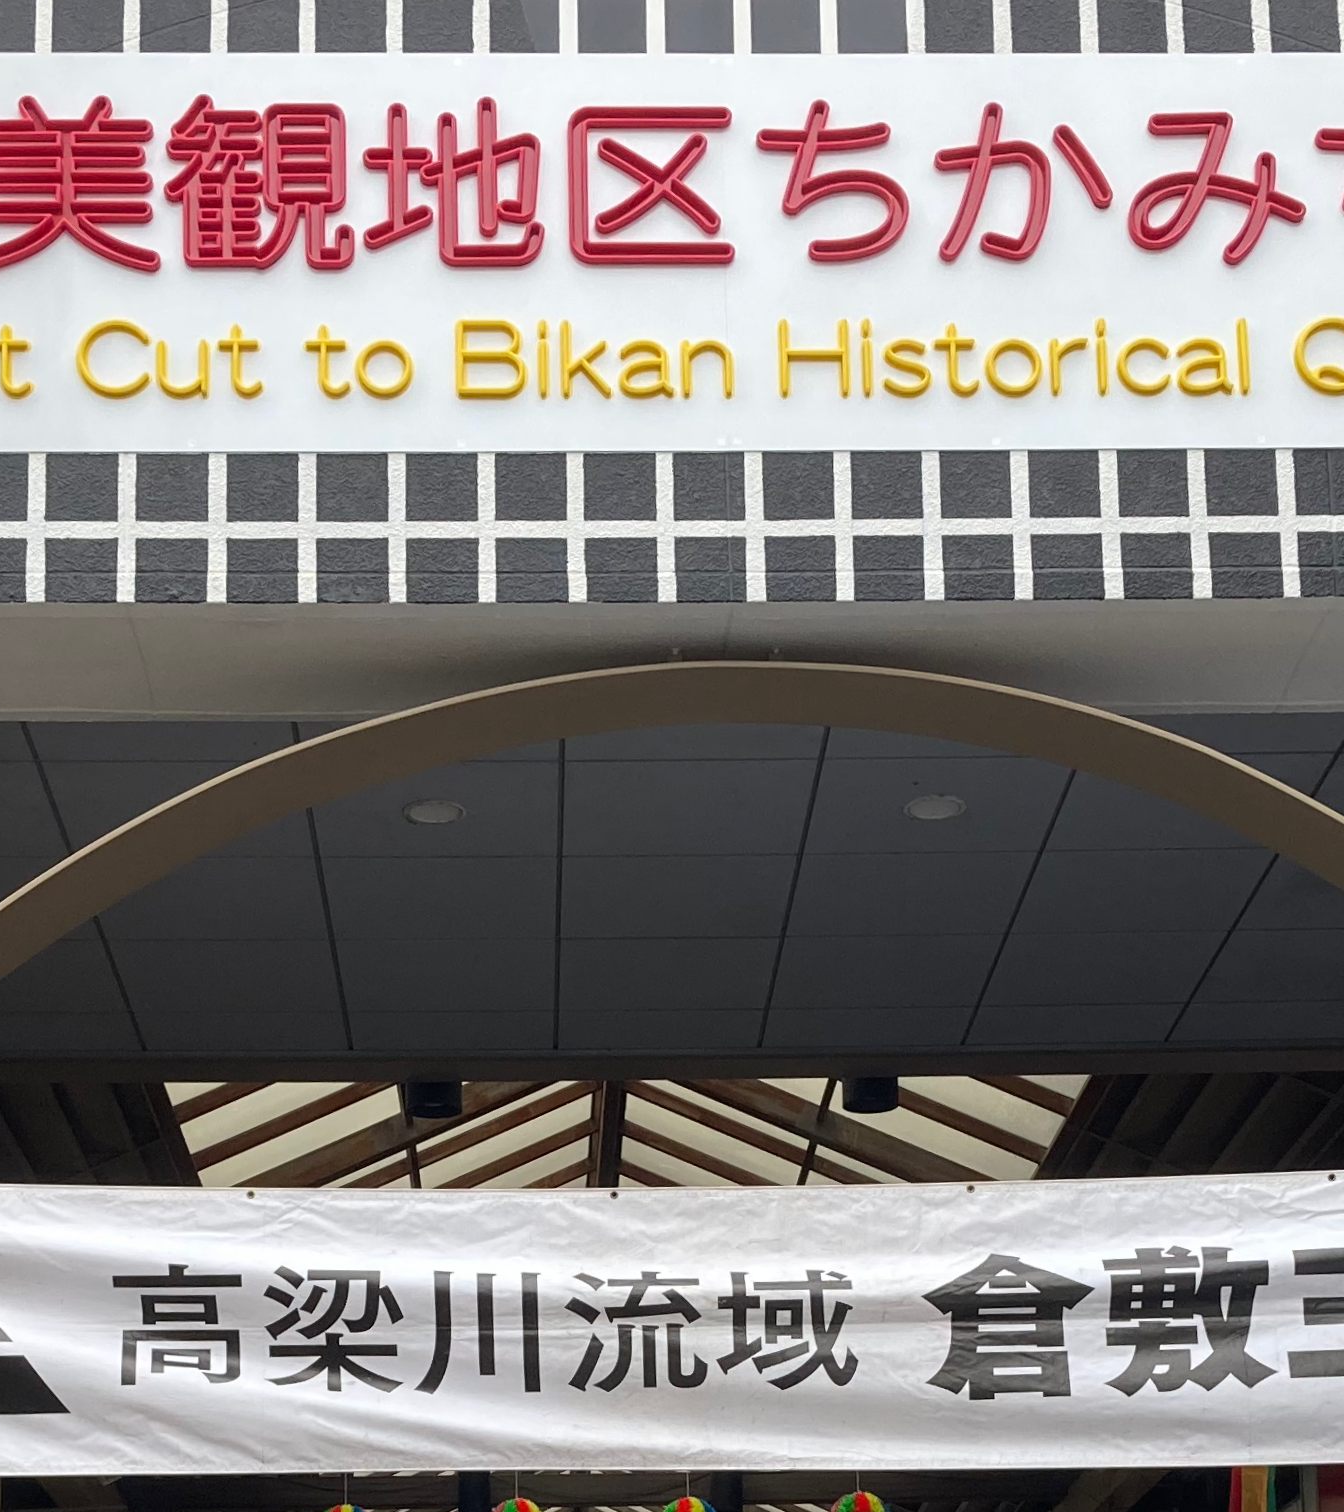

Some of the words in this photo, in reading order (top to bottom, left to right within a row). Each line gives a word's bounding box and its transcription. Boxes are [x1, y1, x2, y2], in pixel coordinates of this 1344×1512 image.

[74, 318, 265, 402] Cut
[303, 324, 415, 402] to
[452, 318, 736, 402] Bikan
[775, 317, 1252, 401] Historical
[113, 1262, 859, 1396] 高梁川流域
